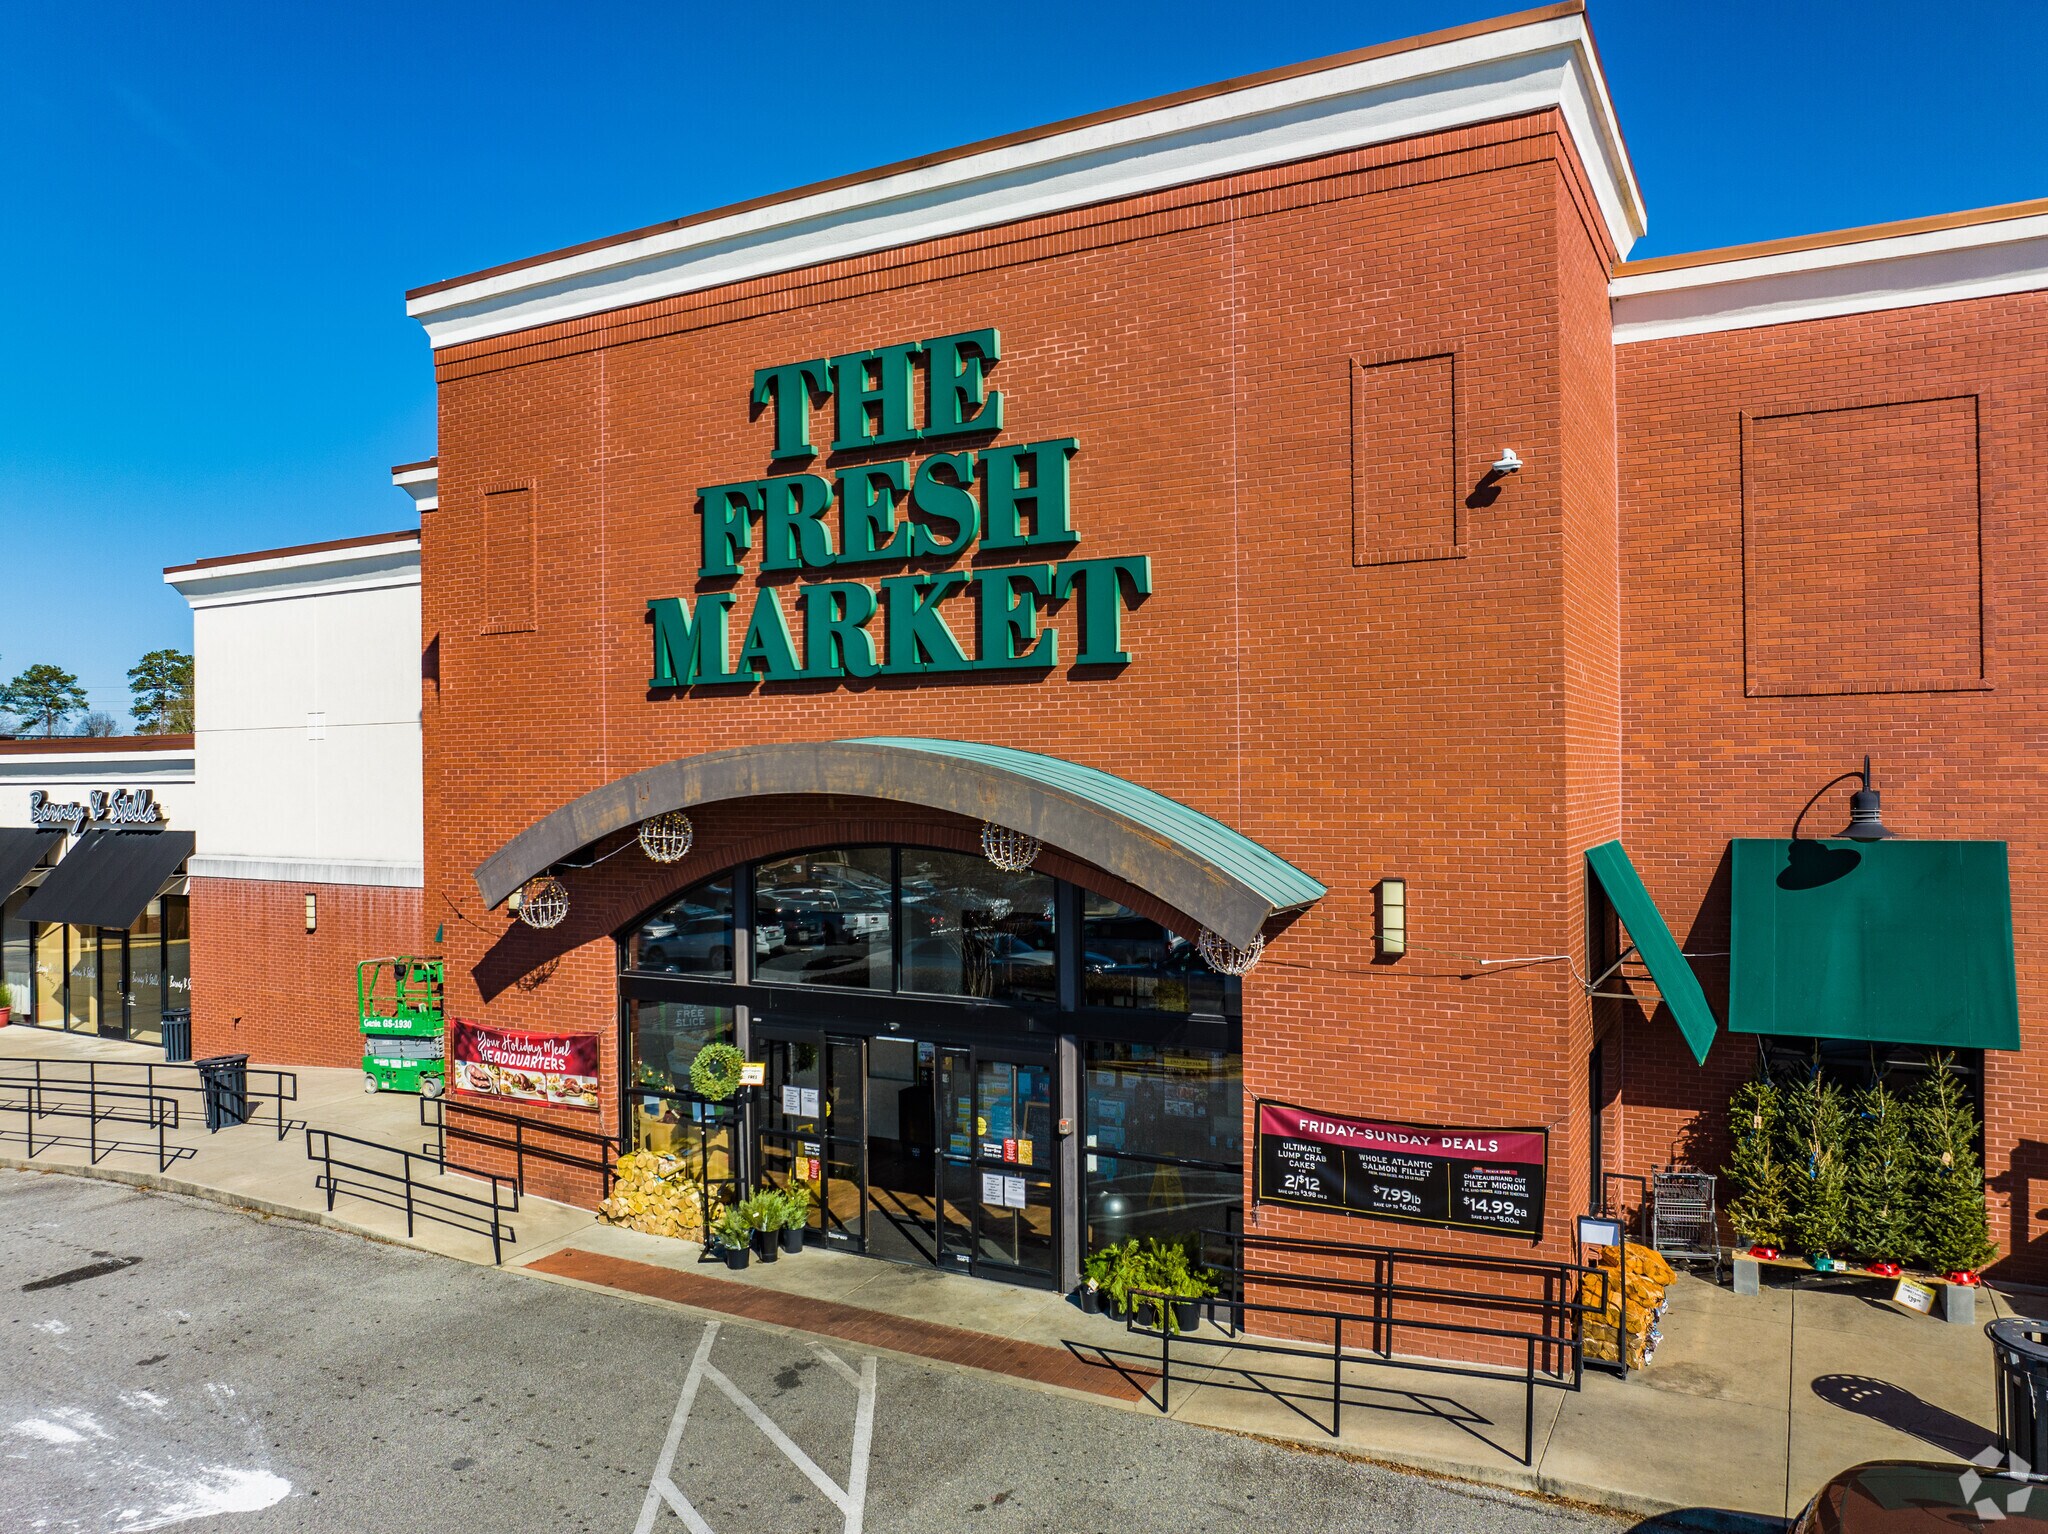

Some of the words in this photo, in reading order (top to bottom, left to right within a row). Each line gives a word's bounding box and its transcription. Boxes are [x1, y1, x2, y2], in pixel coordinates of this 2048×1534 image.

[753, 327, 1003, 460] THE
[696, 437, 1082, 578] FRESH
[647, 554, 1153, 688] MARKET
[30, 790, 84, 833] Barney
[90, 790, 104, 821] &
[109, 788, 157, 824] Stella
[676, 1009, 705, 1018] FREE
[382, 1019, 412, 1029] GS-1930
[675, 1017, 706, 1027] SLICE
[477, 1030, 500, 1051] Your
[501, 1033, 543, 1058] Holiday
[543, 1039, 572, 1059] Meal
[480, 1048, 567, 1071] HEADQUARTERS
[1299, 1119, 1431, 1146] FRIDAY-SUNDAY
[1442, 1137, 1499, 1153] DEALS
[1282, 1142, 1322, 1154] ULTIMATE
[1277, 1150, 1301, 1160] LUMP
[1304, 1153, 1327, 1163] CRAB
[1358, 1153, 1388, 1164] WHOLE
[1391, 1157, 1433, 1169] ATLANTIC
[1289, 1160, 1316, 1170] CAKES
[1362, 1162, 1398, 1174] SALMON
[1401, 1167, 1431, 1177] FILLET
[1284, 1174, 1321, 1191] 2/$12
[1463, 1173, 1513, 1183] CHATEAUBRIAND
[1463, 1180, 1488, 1188] FILET
[1491, 1181, 1526, 1192] MIGNON
[1300, 1189, 1317, 1198] $3.98
[1373, 1184, 1422, 1205] $7.99lb
[1463, 1196, 1527, 1217] $14.99ea
